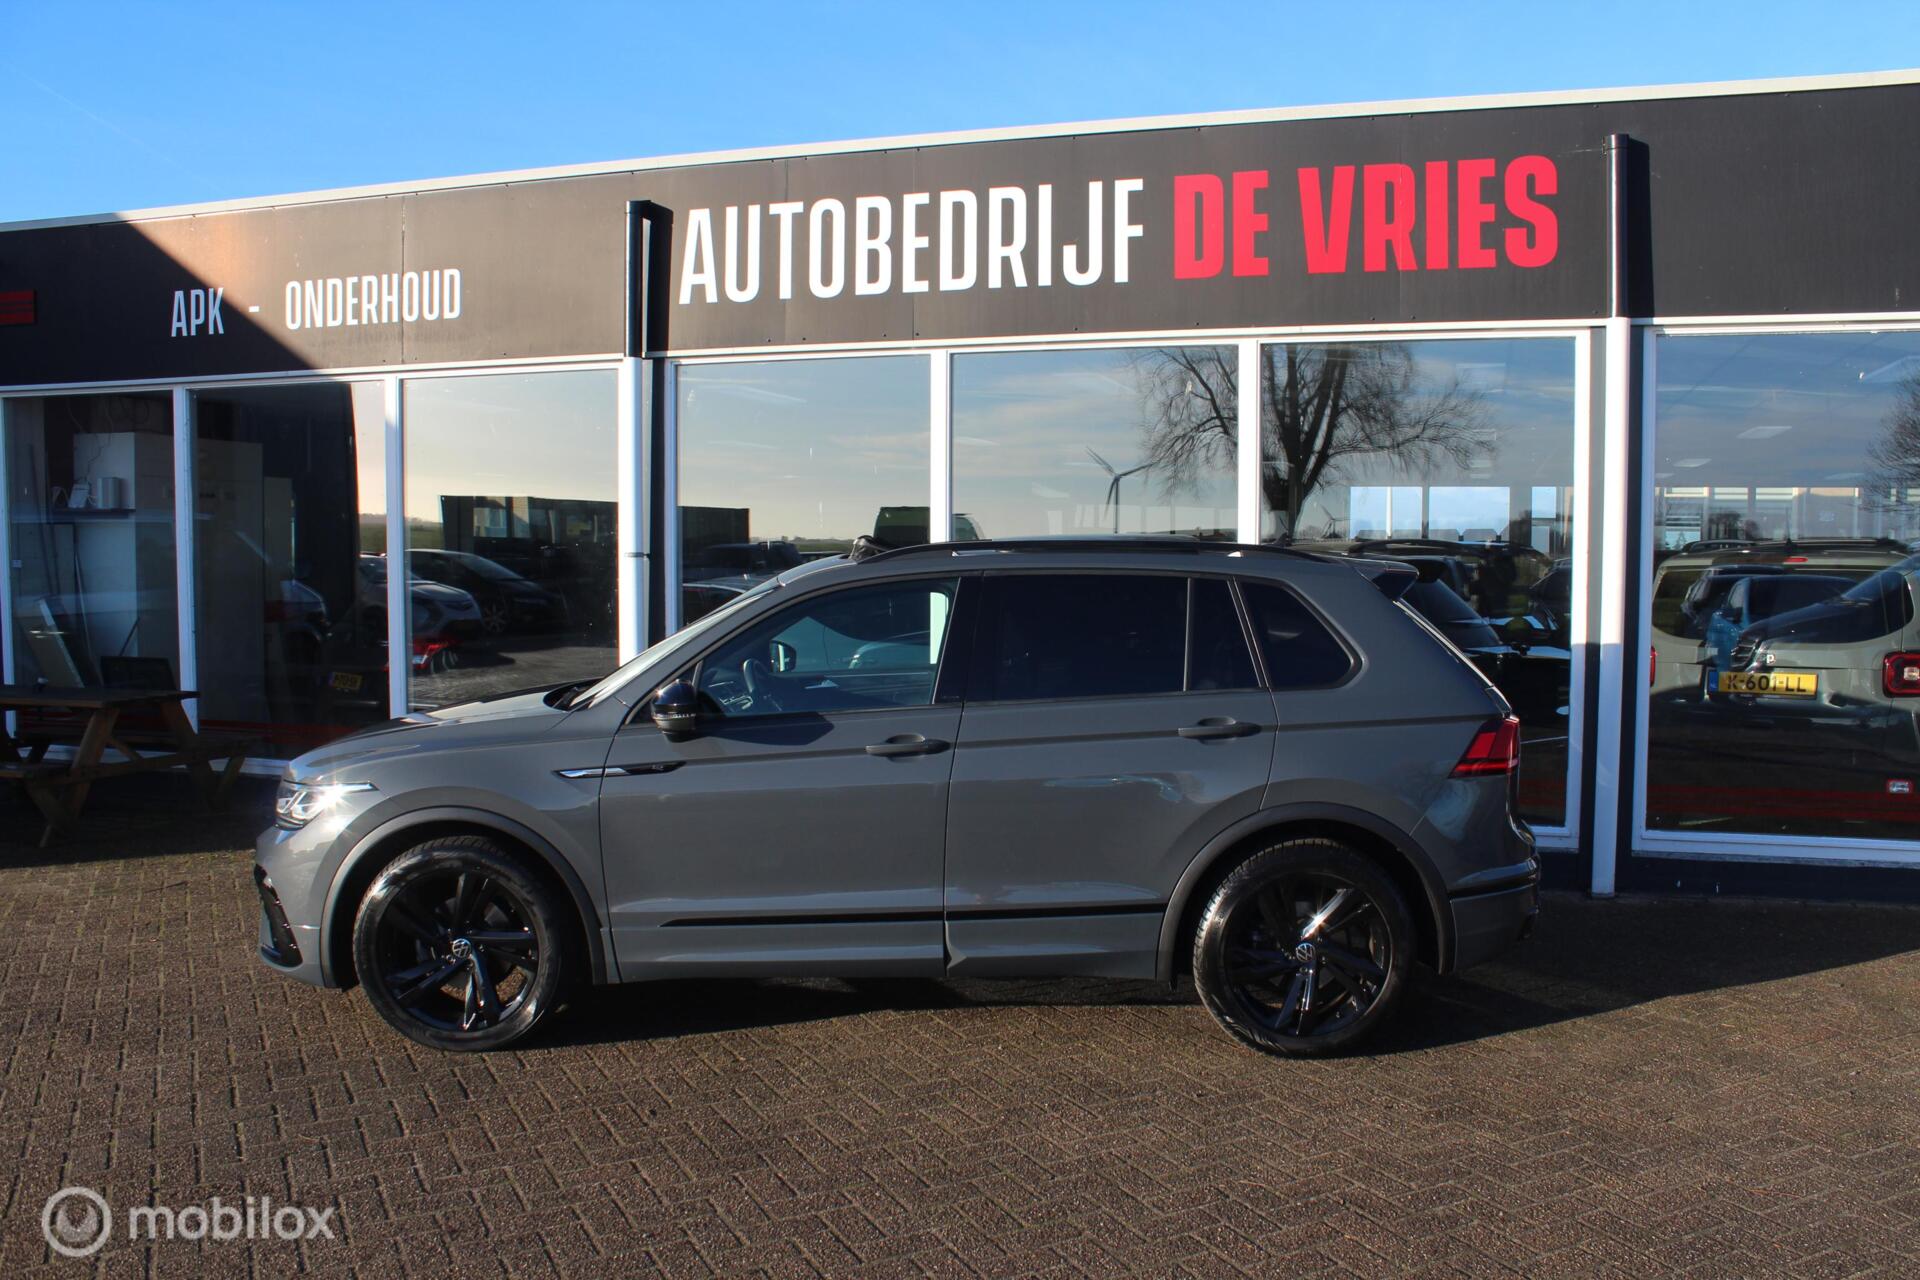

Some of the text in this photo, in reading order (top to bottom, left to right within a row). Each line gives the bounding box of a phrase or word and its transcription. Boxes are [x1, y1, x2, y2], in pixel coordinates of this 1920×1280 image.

[678, 155, 1558, 305] AUTOBEDRIJF DE VRIES
[171, 288, 225, 337] APK
[285, 268, 461, 330] ONDERHOUD
